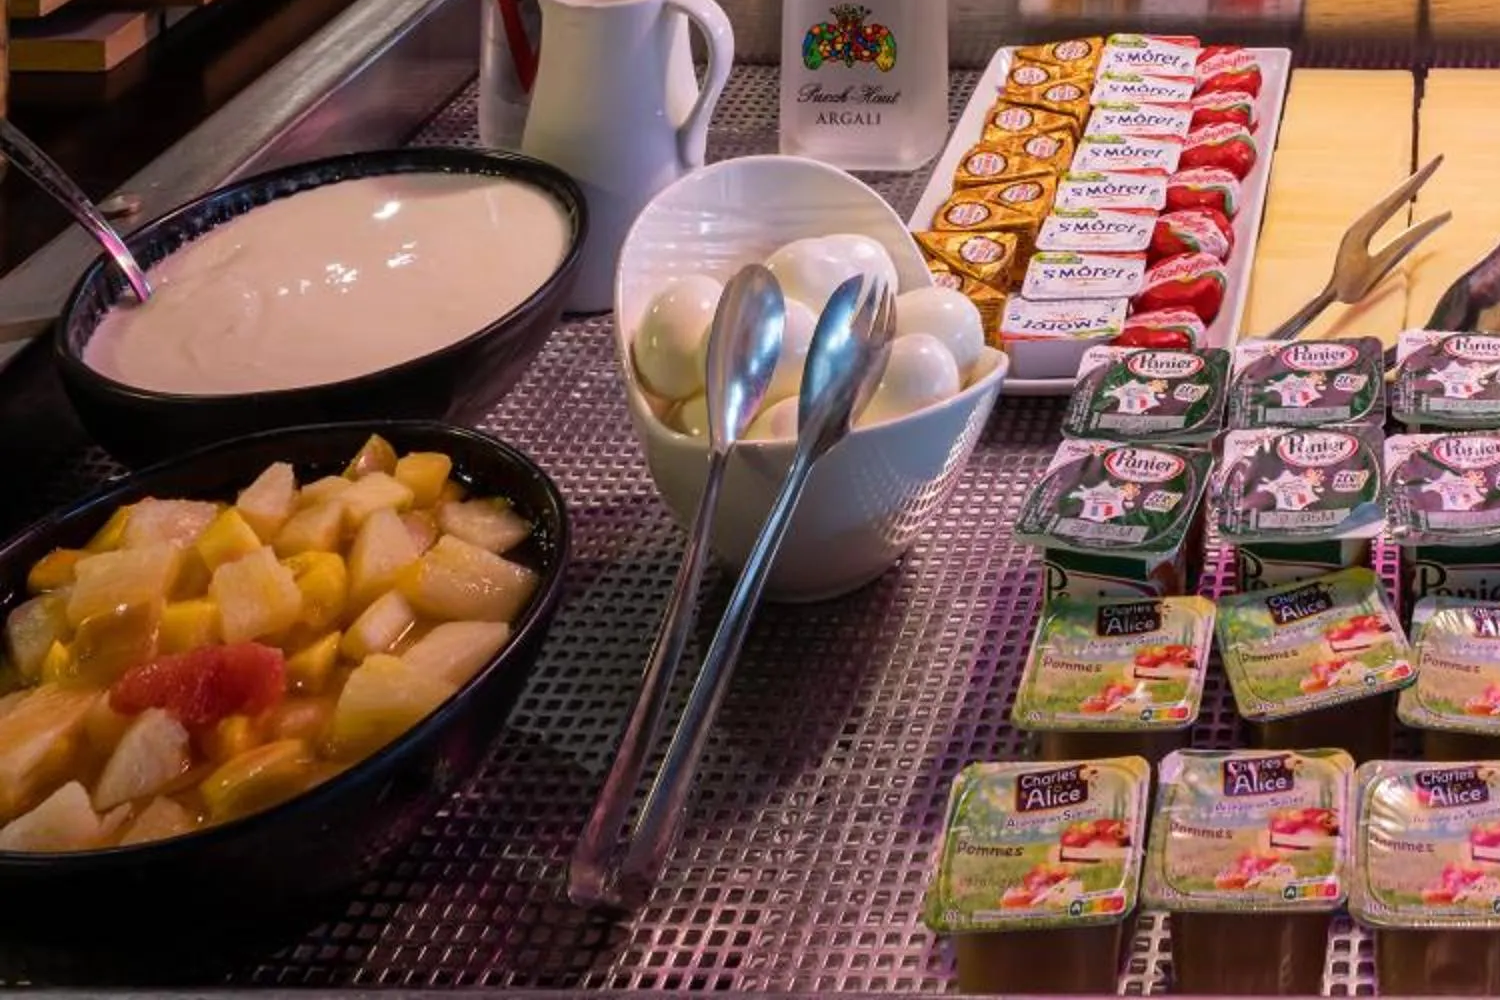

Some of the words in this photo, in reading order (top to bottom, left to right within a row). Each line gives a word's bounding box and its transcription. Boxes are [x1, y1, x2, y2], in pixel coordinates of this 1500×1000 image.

[815, 111, 882, 126] ARGALI
[1291, 342, 1348, 361] Panier
[1139, 352, 1194, 372] Panier
[1116, 449, 1175, 472] Panier
[1105, 616, 1156, 635] Alice
[1042, 655, 1103, 673] Pommes
[1020, 767, 1078, 790] Charles
[1232, 774, 1288, 796] Alice
[1025, 787, 1082, 810] Alice
[1428, 786, 1483, 807] Alice
[957, 842, 1025, 858] Pommes
